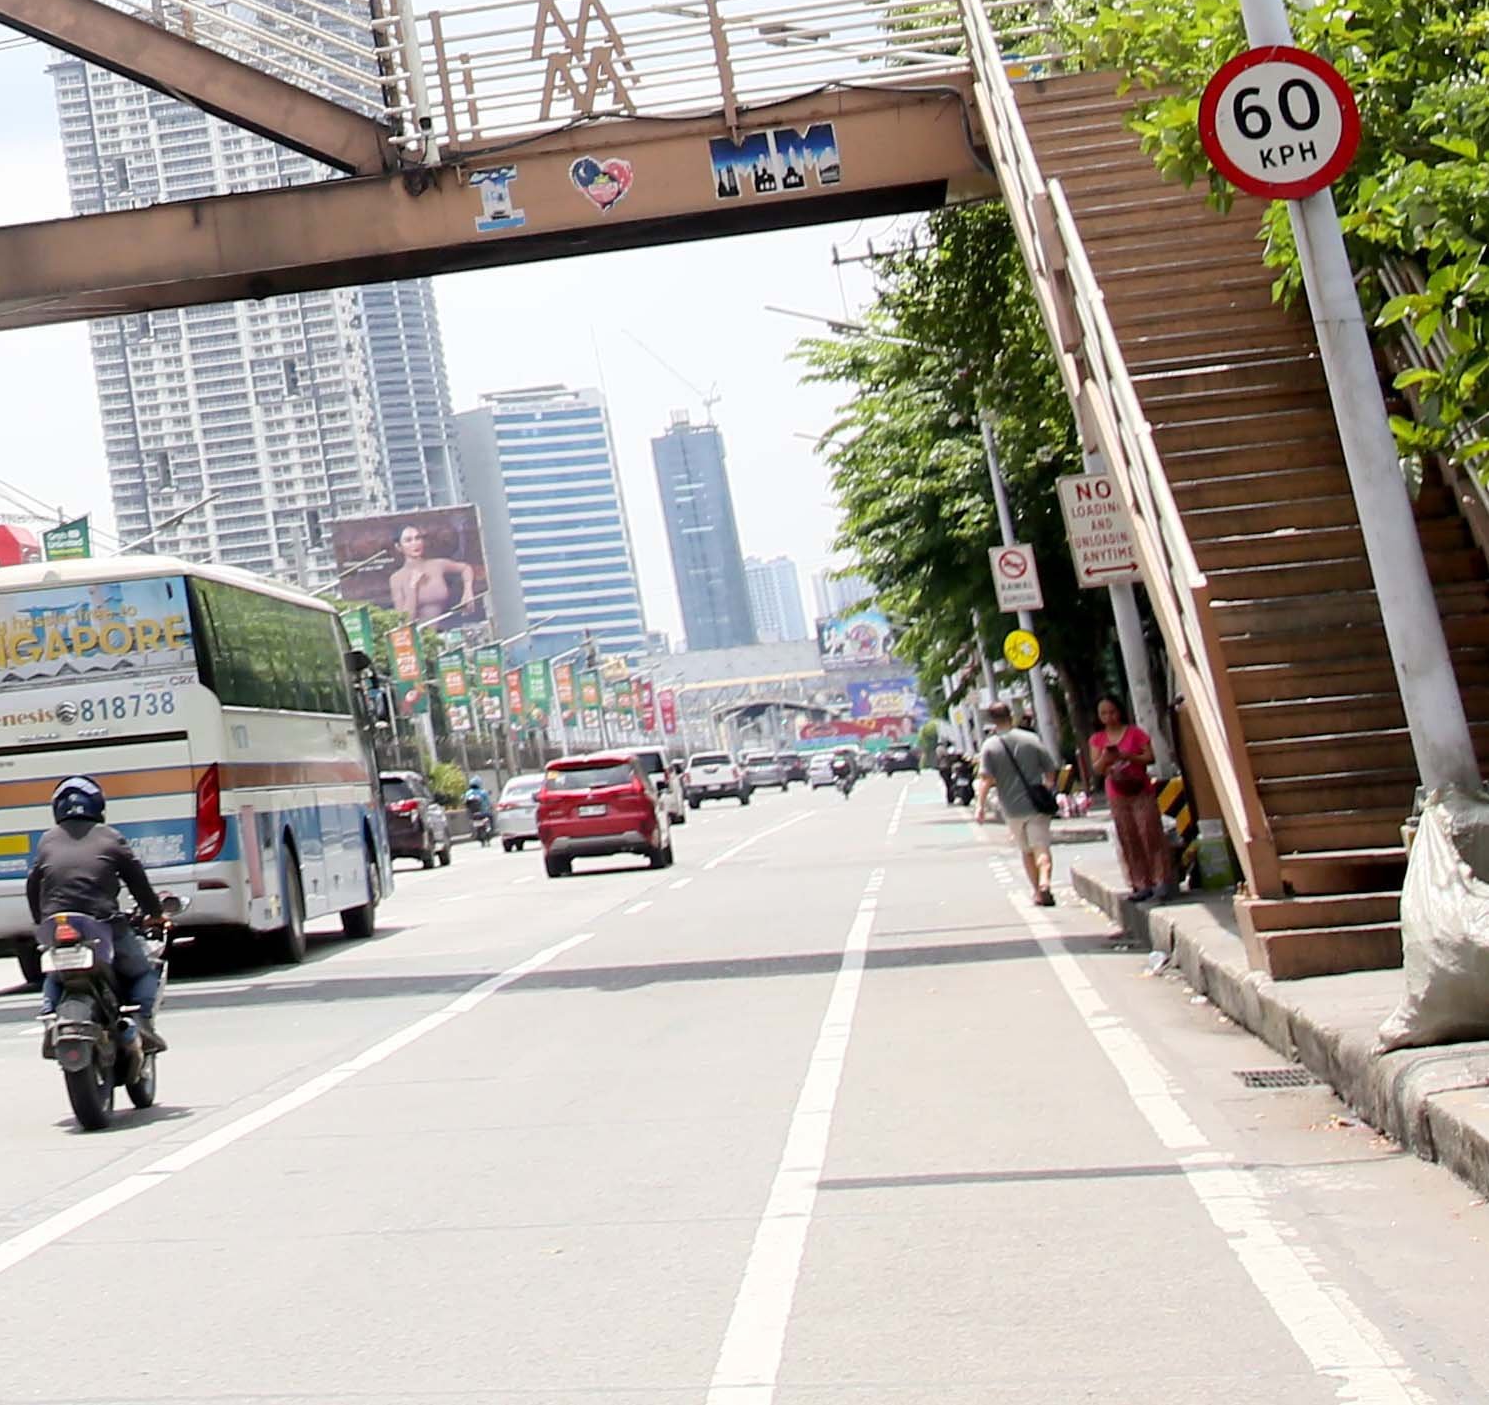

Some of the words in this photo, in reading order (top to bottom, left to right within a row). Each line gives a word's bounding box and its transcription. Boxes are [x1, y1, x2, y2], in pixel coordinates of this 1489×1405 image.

[1233, 78, 1321, 140] 60
[709, 122, 841, 200] MM
[1259, 140, 1318, 169] KPH
[1076, 481, 1111, 502] NO
[1072, 502, 1120, 518] LOADIN
[1091, 518, 1113, 530] AND
[1075, 532, 1129, 548] UNLOADIN
[1083, 545, 1133, 563] ANYTIME
[81, 691, 175, 723] 818738
